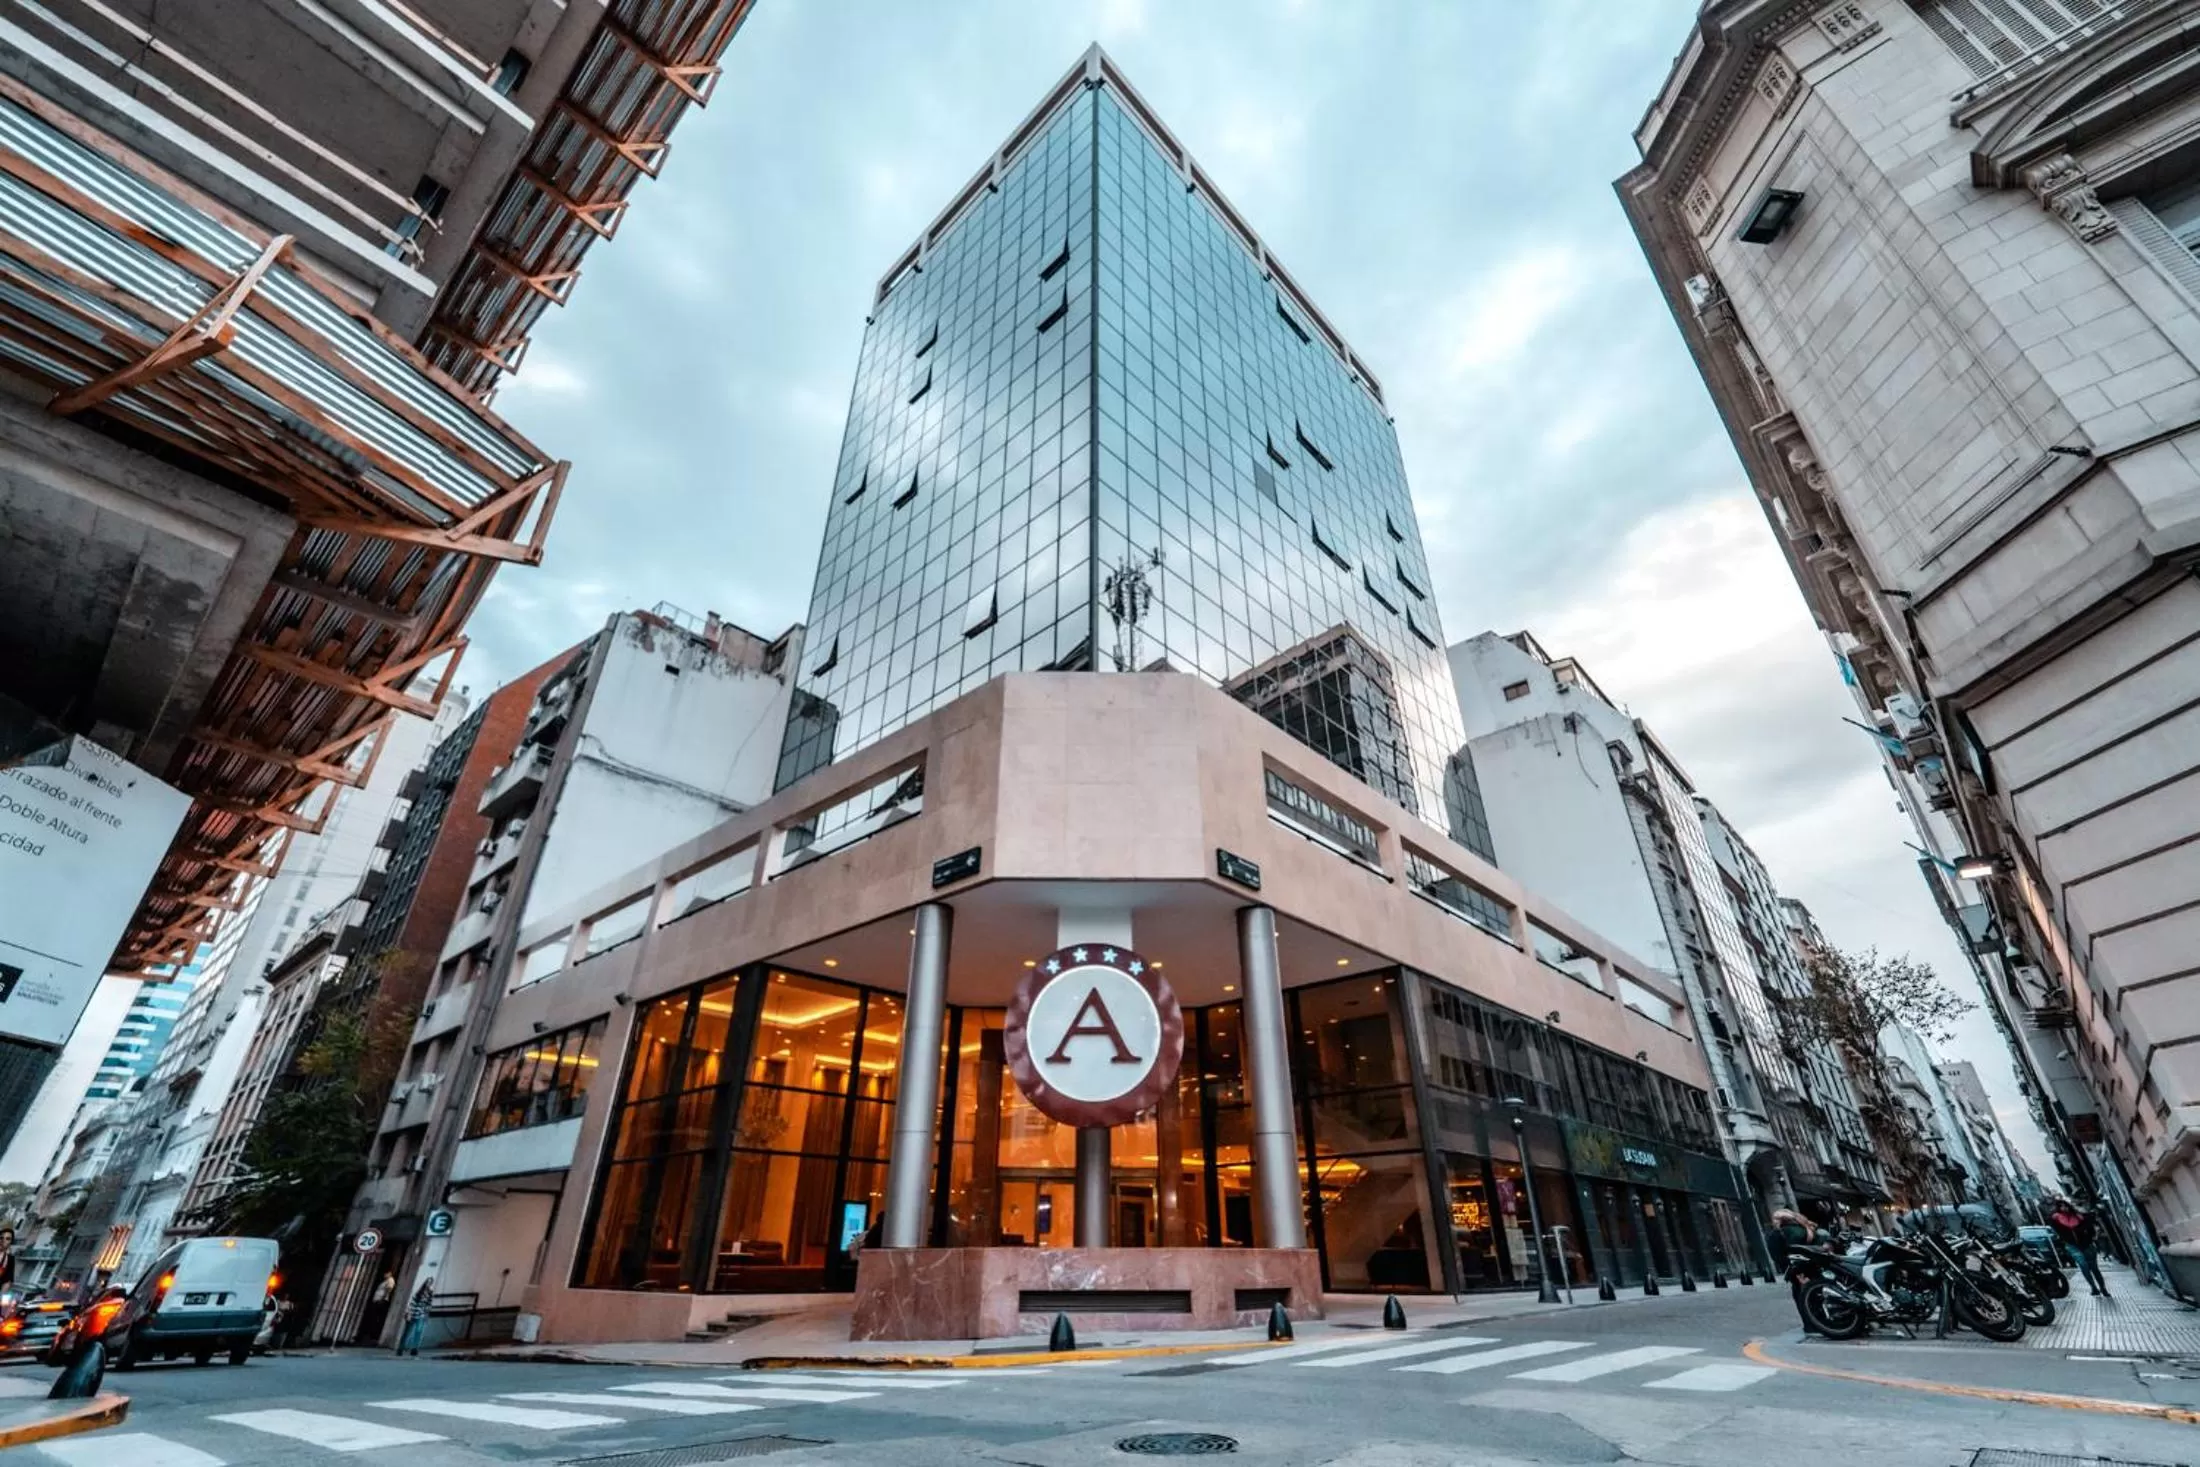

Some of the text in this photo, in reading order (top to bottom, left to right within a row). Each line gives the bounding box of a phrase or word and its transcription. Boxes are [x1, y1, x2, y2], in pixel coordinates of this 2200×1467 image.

[62, 760, 123, 798] Diviibles
[0, 794, 88, 844] Doble Altura
[70, 796, 84, 809] al
[84, 801, 122, 828] frente
[0, 832, 45, 856] cidad
[1045, 987, 1143, 1064] A
[434, 1216, 449, 1230] E
[360, 1235, 376, 1247] 20
